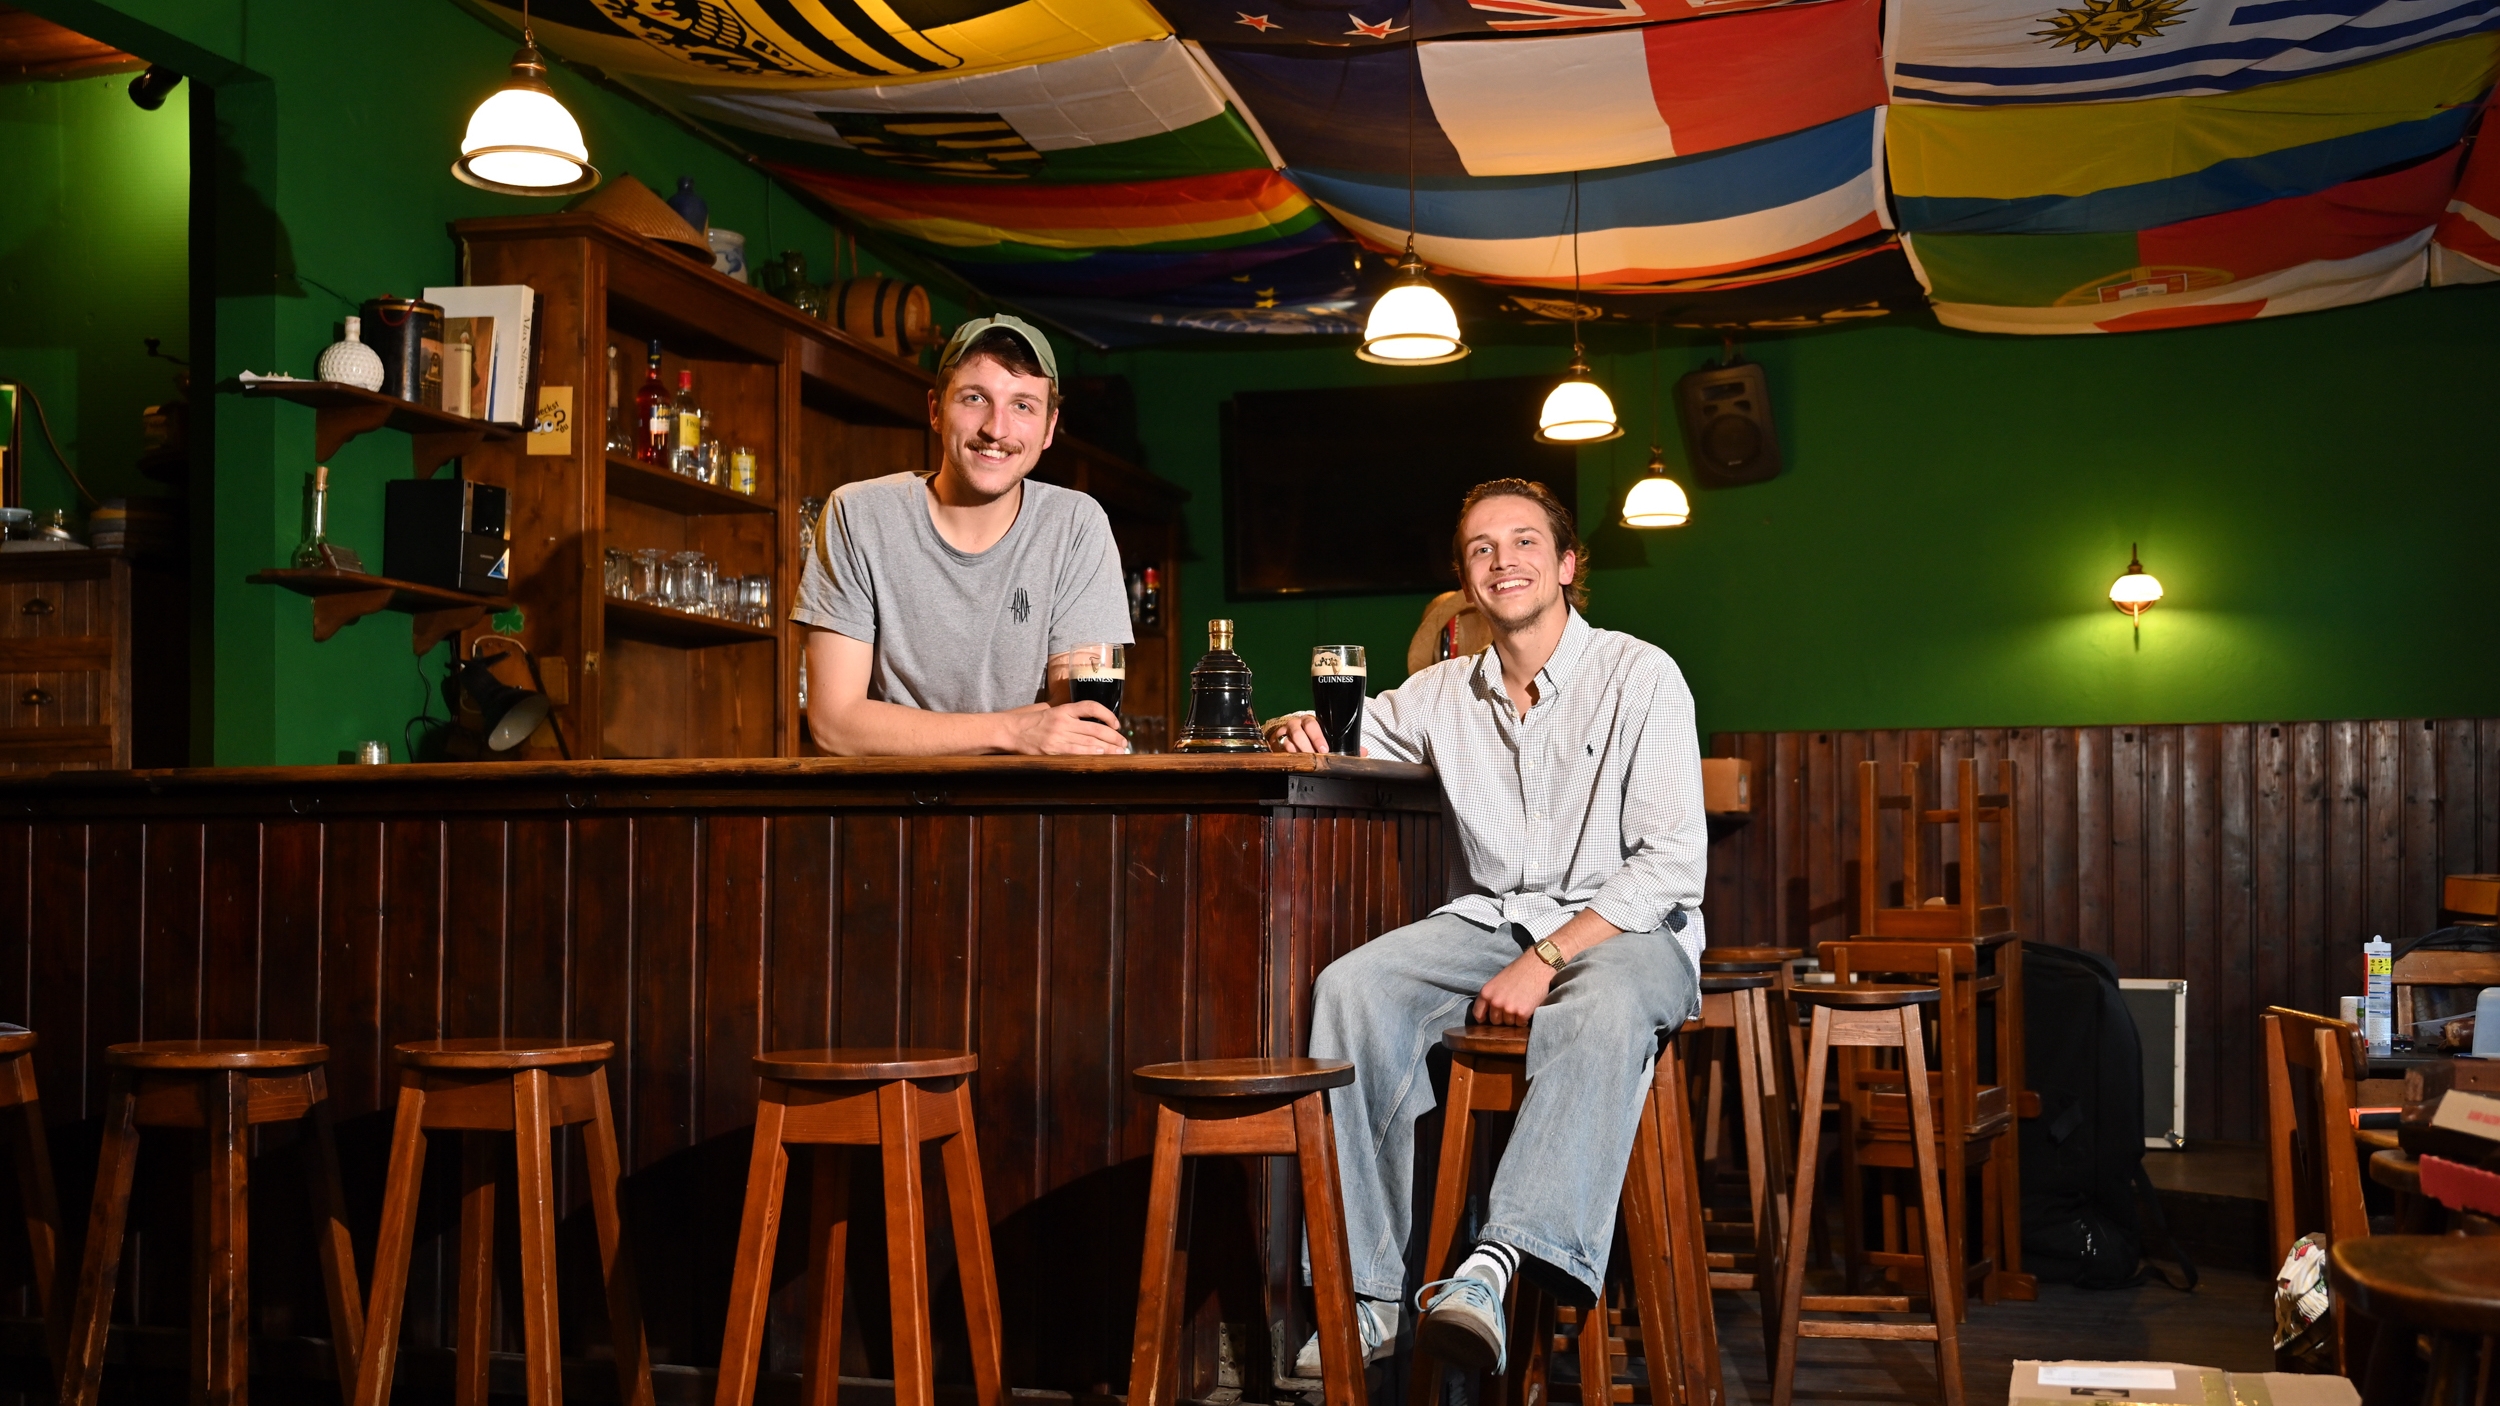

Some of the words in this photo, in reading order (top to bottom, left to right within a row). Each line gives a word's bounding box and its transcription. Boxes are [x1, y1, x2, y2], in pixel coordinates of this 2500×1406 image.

[522, 315, 531, 343] Max
[518, 346, 528, 390] Slevogt
[1077, 674, 1114, 683] GUINNESS
[1318, 675, 1354, 684] GUINNESS
